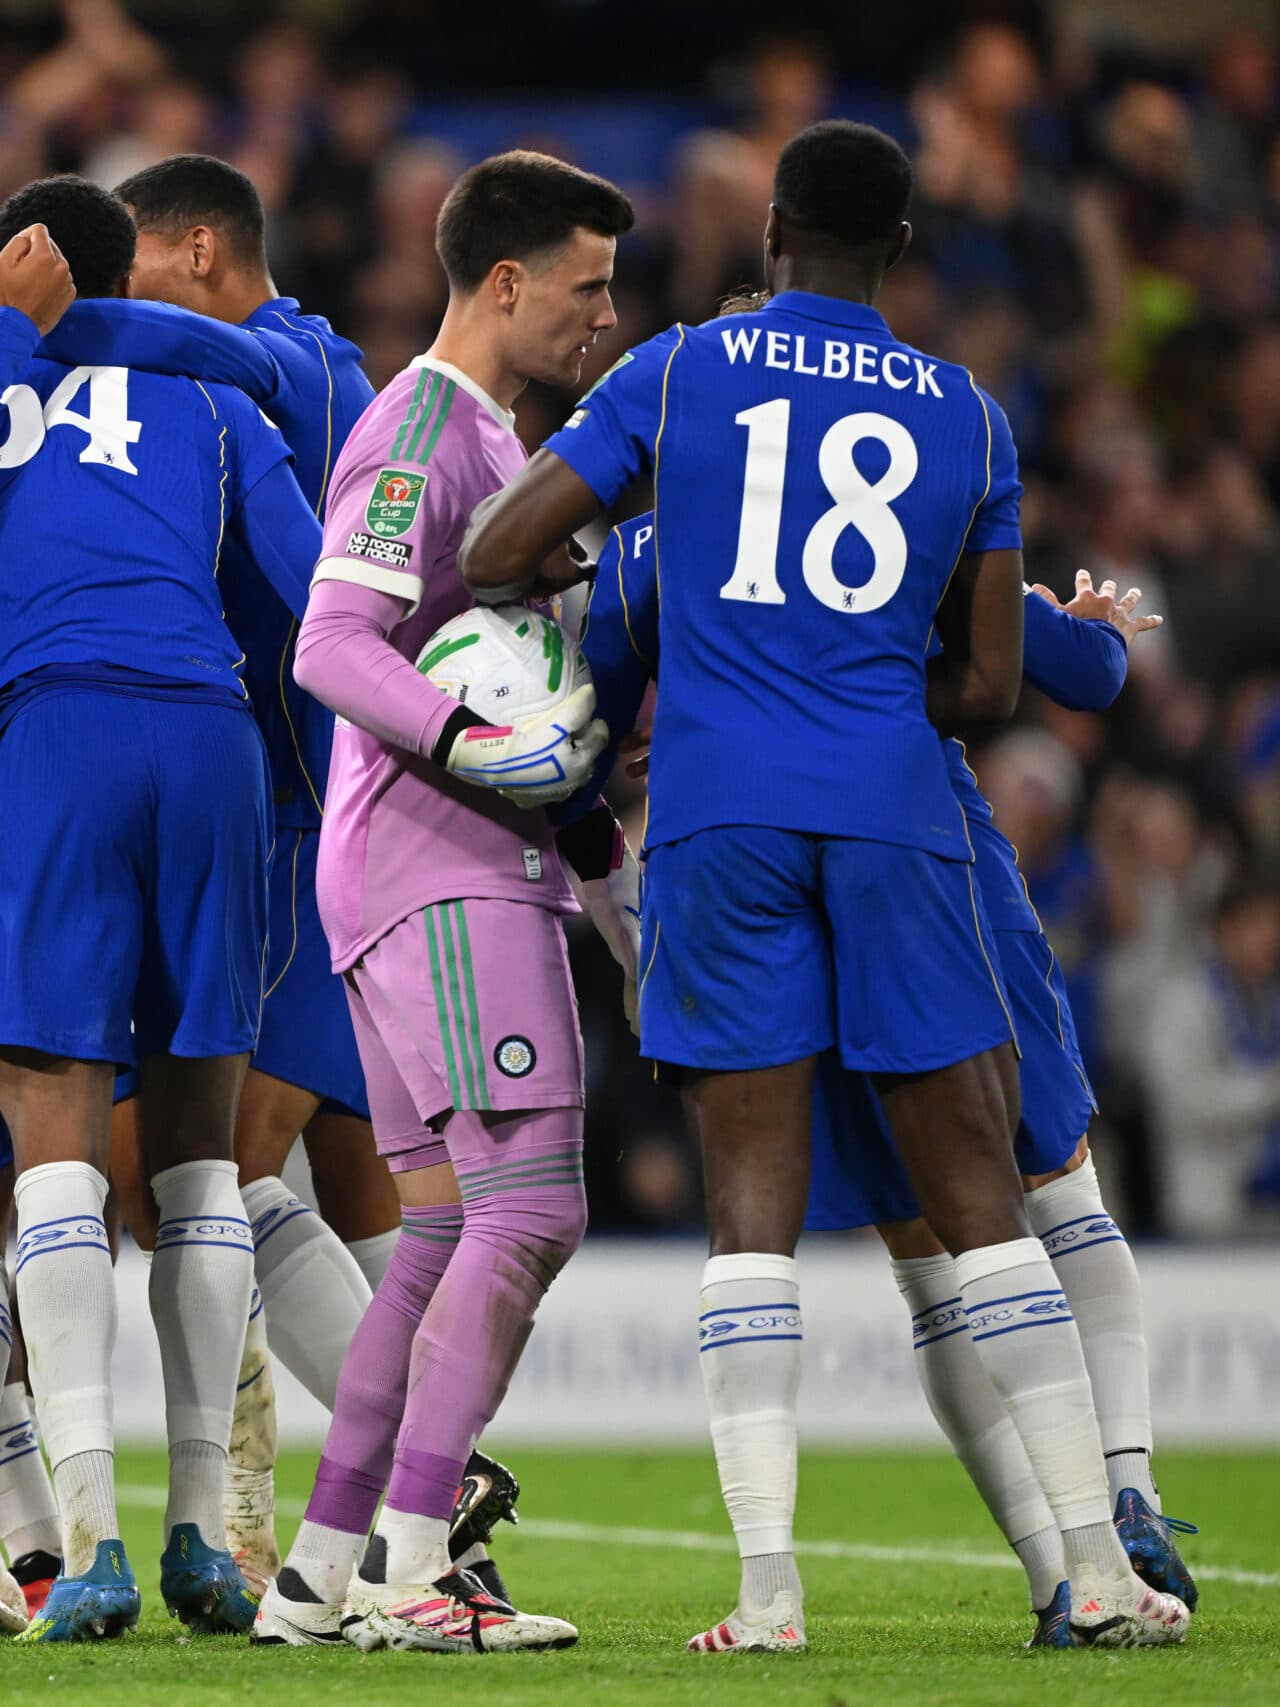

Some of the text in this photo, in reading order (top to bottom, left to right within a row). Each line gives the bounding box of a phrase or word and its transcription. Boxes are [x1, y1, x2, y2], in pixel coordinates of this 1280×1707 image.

[721, 328, 944, 398] WELBECK
[371, 499, 416, 508] Carabao
[380, 508, 401, 518] Cup
[720, 398, 919, 614] 18
[349, 533, 407, 556] No room
[345, 544, 409, 568] for racism
[77, 1225, 106, 1238] CF
[196, 1225, 248, 1238] CFC
[748, 1316, 798, 1328] CFC
[933, 1307, 967, 1326] CF
[970, 1310, 1013, 1329] CFC
